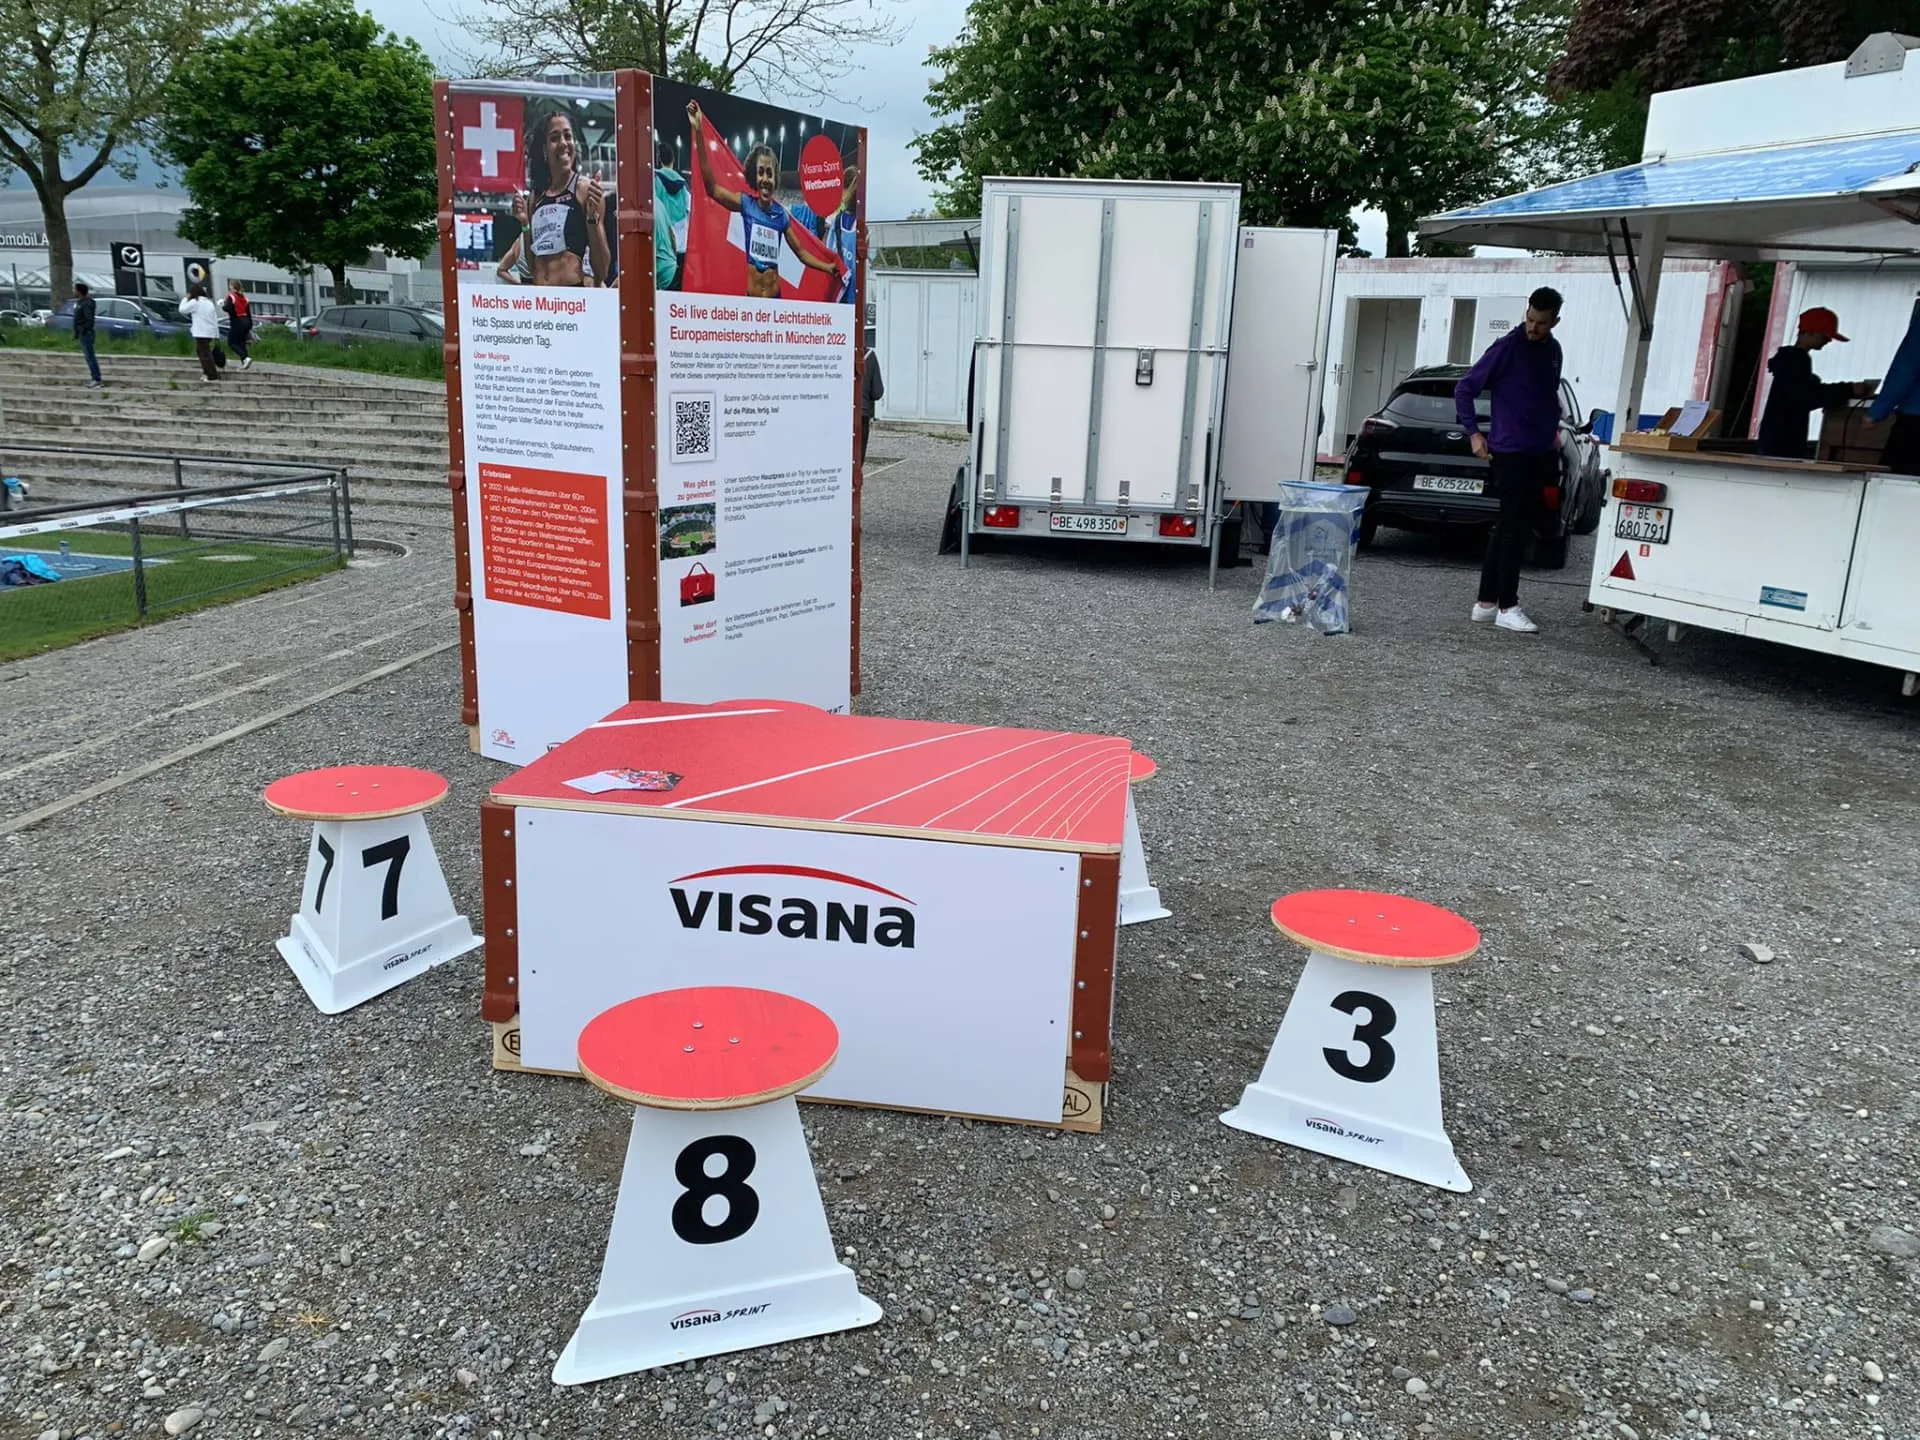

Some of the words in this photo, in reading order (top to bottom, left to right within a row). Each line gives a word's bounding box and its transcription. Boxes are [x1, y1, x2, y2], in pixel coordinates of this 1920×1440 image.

[802, 164, 822, 174] Visana
[824, 161, 840, 174] Sprint
[804, 178, 840, 190] Wettbewerb
[471, 294, 508, 308] Machs
[512, 295, 531, 309] wie
[535, 296, 585, 314] Mujinga!
[669, 303, 686, 318] Sei
[690, 304, 707, 319] live
[711, 306, 737, 321] dabei
[741, 311, 752, 321] an
[755, 309, 769, 322] der
[773, 310, 831, 325] Leichtathletik
[472, 316, 488, 327] Hab
[490, 317, 514, 330] Spass
[516, 318, 531, 328] und
[533, 319, 553, 330] erleb
[555, 321, 577, 331] einen
[472, 332, 533, 346] unvergesslichen
[535, 335, 552, 347] Tag.
[670, 326, 772, 344] Europameisterschaft
[775, 330, 782, 342] in
[786, 330, 824, 344] München
[826, 332, 845, 344] 2022
[1637, 507, 1650, 520] BE
[1618, 520, 1641, 538] 680
[1643, 522, 1665, 540] 791
[362, 835, 411, 920] 7
[1322, 990, 1398, 1084] 3
[671, 1134, 760, 1244] 8
[722, 1303, 772, 1321] SPRINT
